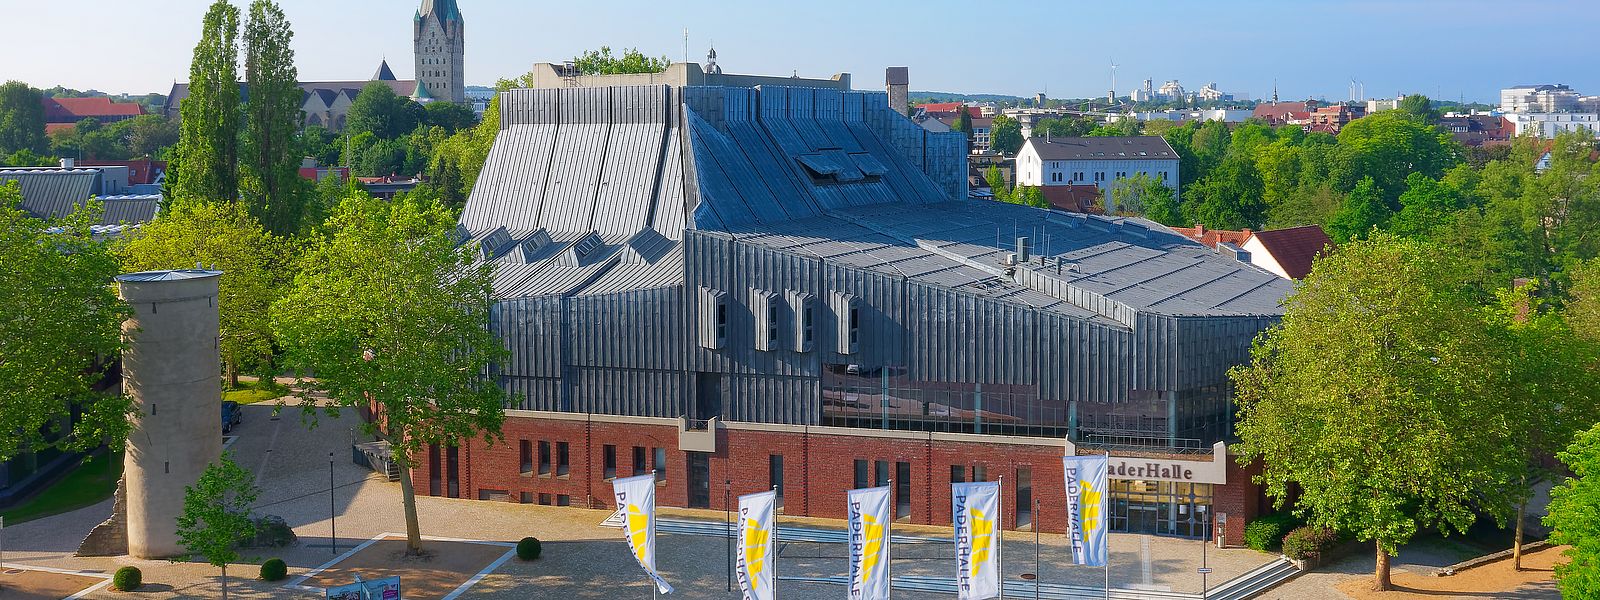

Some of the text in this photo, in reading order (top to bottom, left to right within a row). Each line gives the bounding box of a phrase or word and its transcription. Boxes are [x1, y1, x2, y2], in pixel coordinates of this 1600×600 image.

[1066, 467, 1081, 553] PADERHALLE
[1108, 462, 1192, 479] aderHalle
[851, 501, 863, 597] PADERHALLE
[956, 495, 970, 592] PADERHALLE
